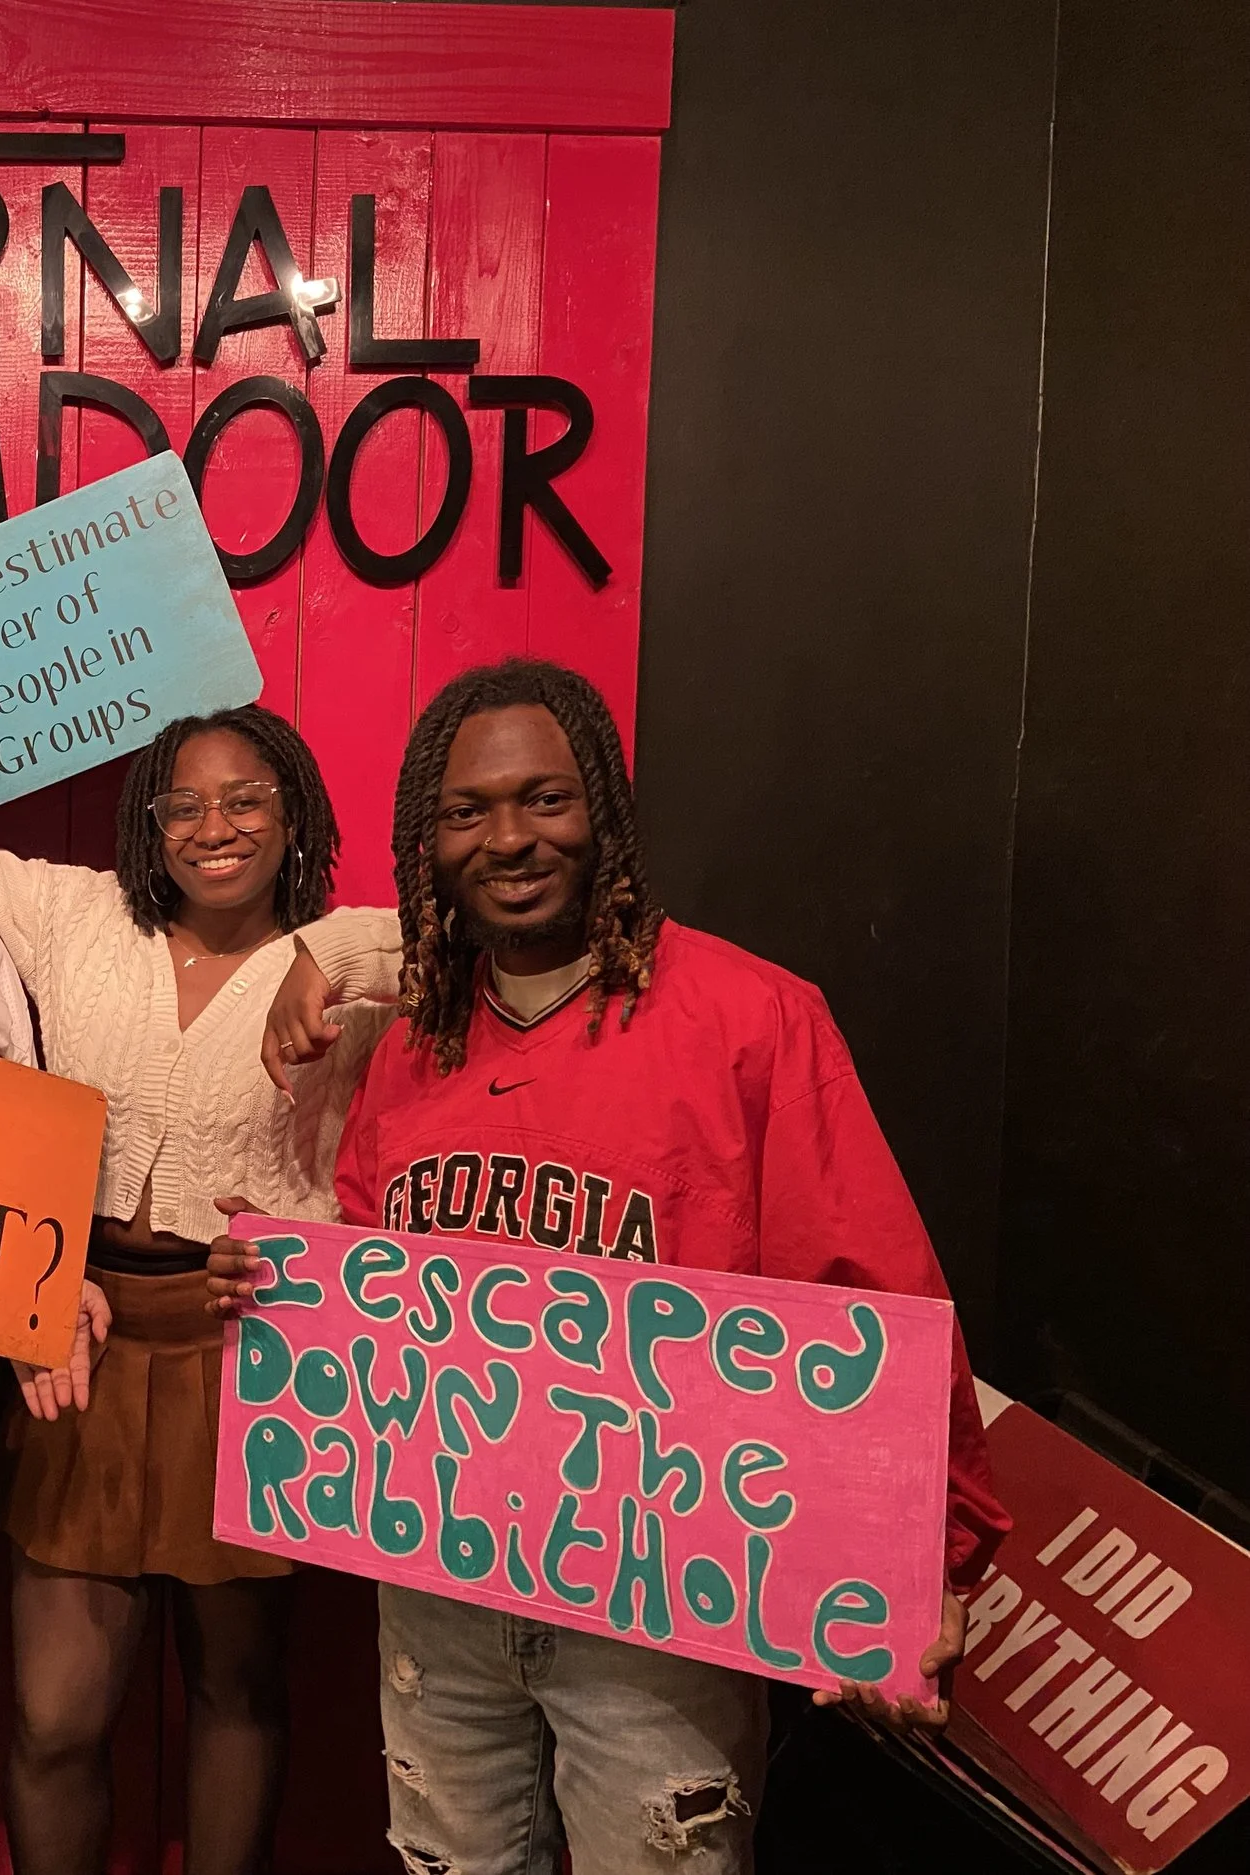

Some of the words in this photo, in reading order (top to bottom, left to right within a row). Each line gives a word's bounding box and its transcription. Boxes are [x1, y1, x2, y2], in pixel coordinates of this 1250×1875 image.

[56, 572, 101, 622] of
[107, 627, 154, 664] in
[383, 1152, 657, 1264] GEORGIA
[252, 1235, 324, 1308] I
[547, 1384, 796, 1532] The
[1035, 1506, 1099, 1566] I
[1061, 1527, 1192, 1640] DID
[956, 1563, 1229, 1842] RYTHING
